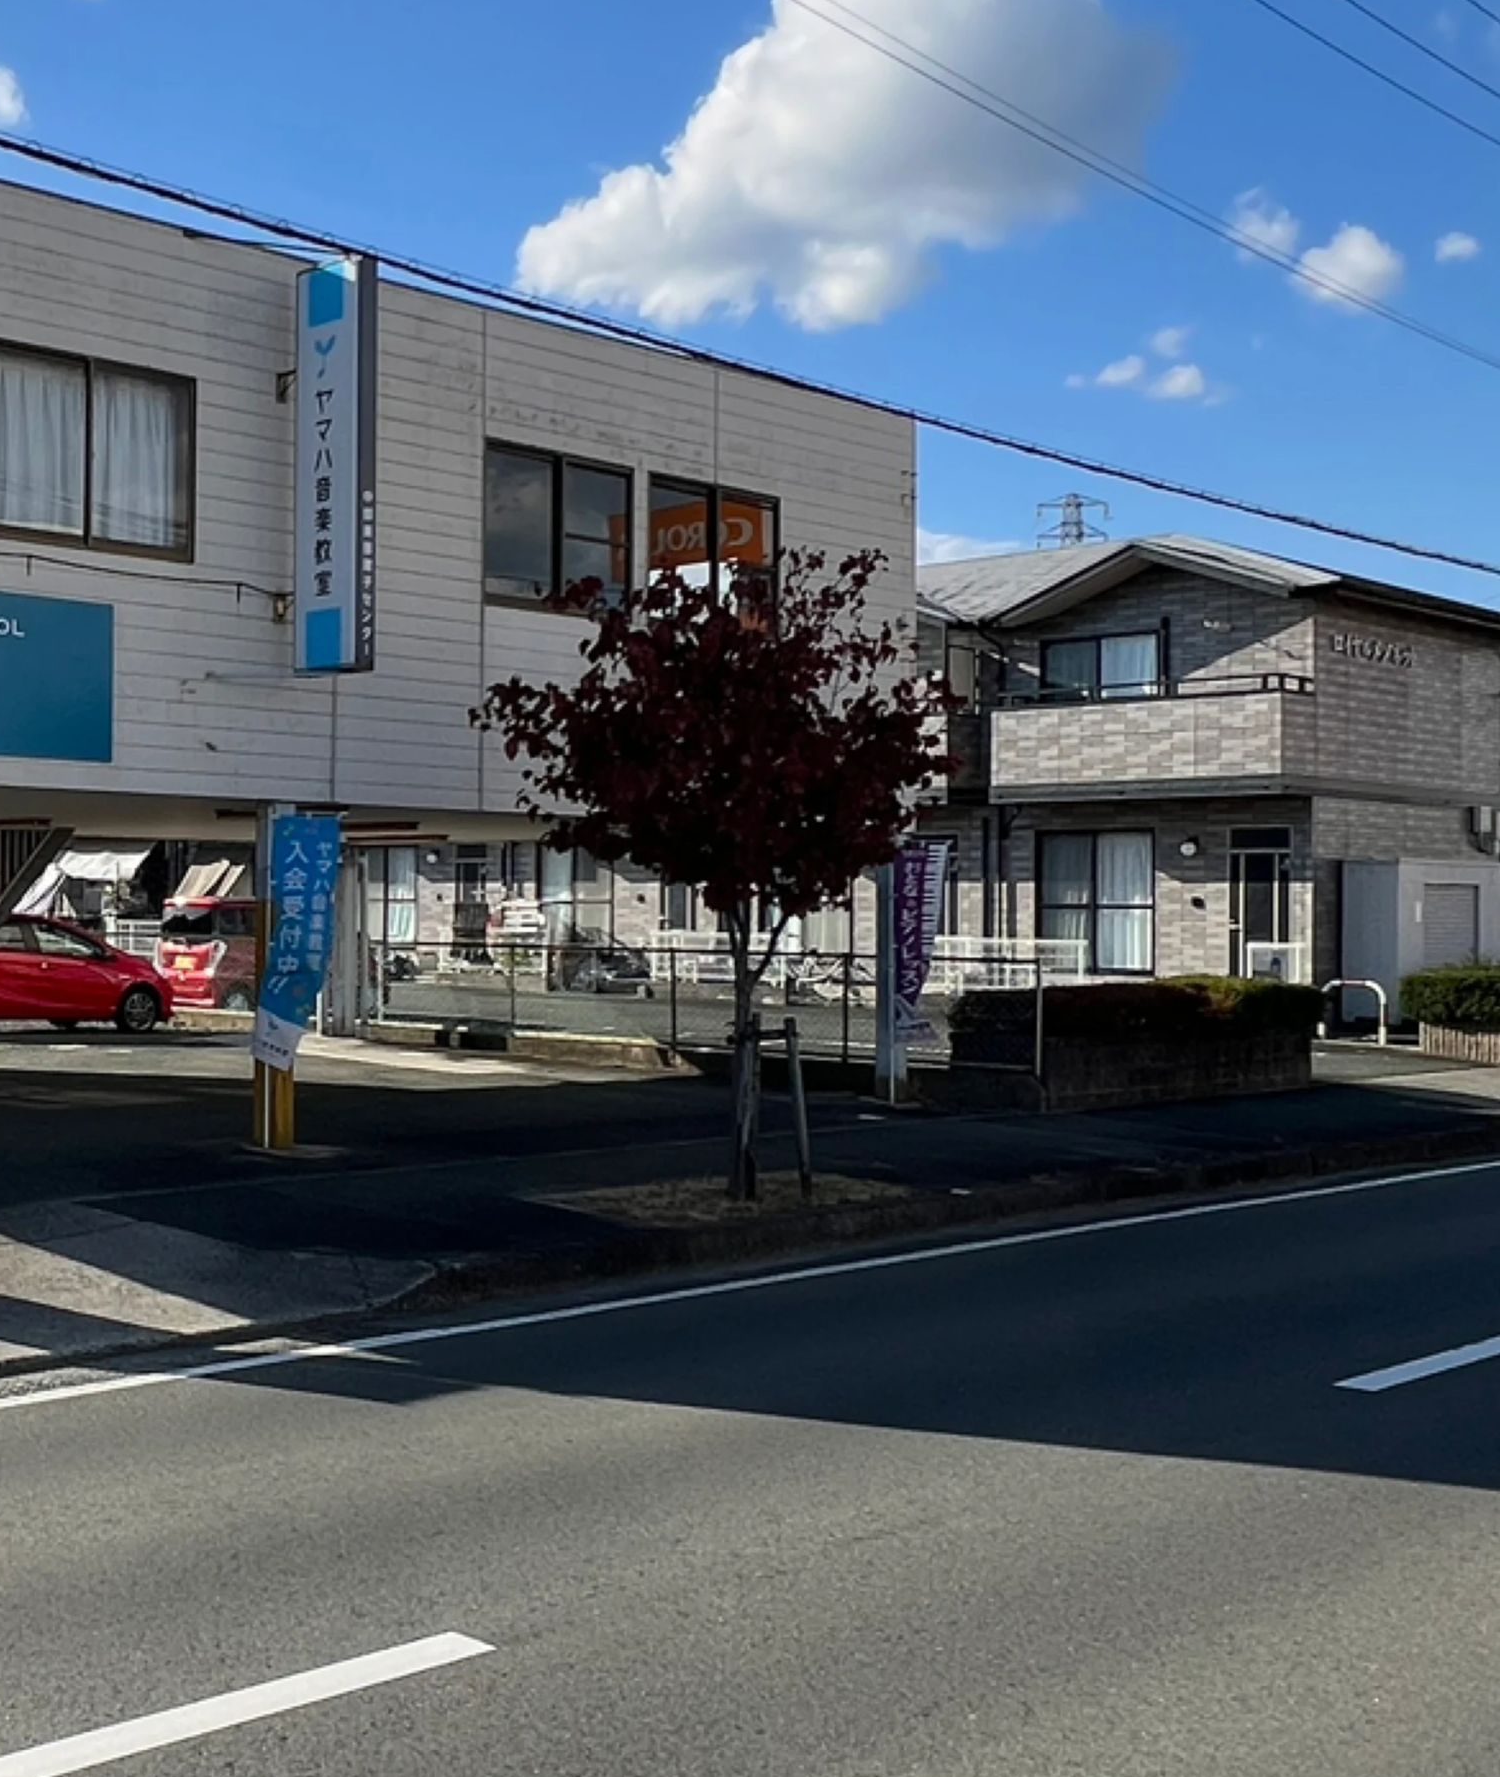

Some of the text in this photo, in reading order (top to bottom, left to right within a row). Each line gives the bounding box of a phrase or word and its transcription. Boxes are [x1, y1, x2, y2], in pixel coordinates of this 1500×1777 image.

[314, 388, 334, 597] ヤマハ音楽教室
